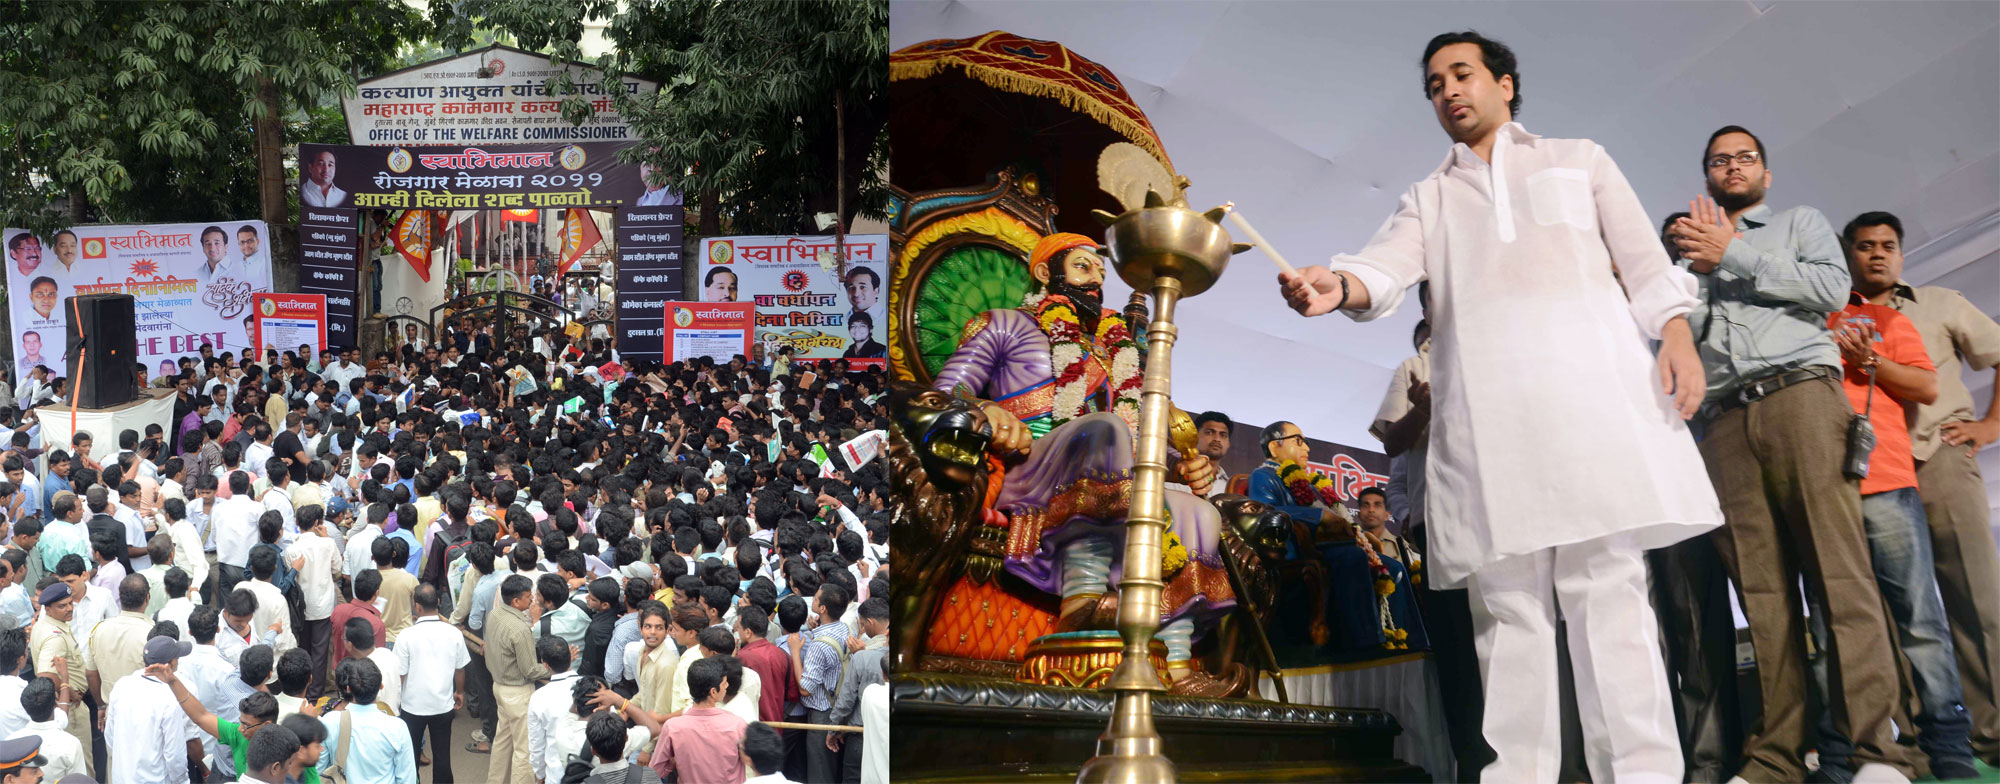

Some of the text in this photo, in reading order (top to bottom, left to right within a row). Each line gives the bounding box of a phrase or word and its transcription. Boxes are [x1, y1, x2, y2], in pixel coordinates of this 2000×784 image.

[361, 86, 434, 99] कल्याण
[439, 85, 505, 101] आयुक्त
[363, 103, 436, 118] महाराष्ट्र
[442, 101, 515, 115] कामगार
[369, 126, 628, 141] OFFICE OF THE WELFARE COMMISSIONER
[419, 148, 553, 169] स्वाभिमान
[373, 172, 449, 189] रोजगार
[455, 172, 524, 189] मेळावा
[354, 190, 410, 207] आम्ही
[415, 190, 480, 207] दिलेला
[484, 193, 525, 207] शब्द
[108, 230, 192, 250] स्वाभिमान
[124, 275, 198, 297] दिनानिमित्त
[135, 301, 155, 309] जगार
[277, 300, 317, 310] स्वाभिमान
[776, 291, 836, 306] वर्धापन
[696, 309, 744, 319] स्वाभिमान
[789, 311, 843, 326] निमित्त
[136, 321, 172, 332] मेदवारांना
[136, 332, 227, 356] HE BEST
